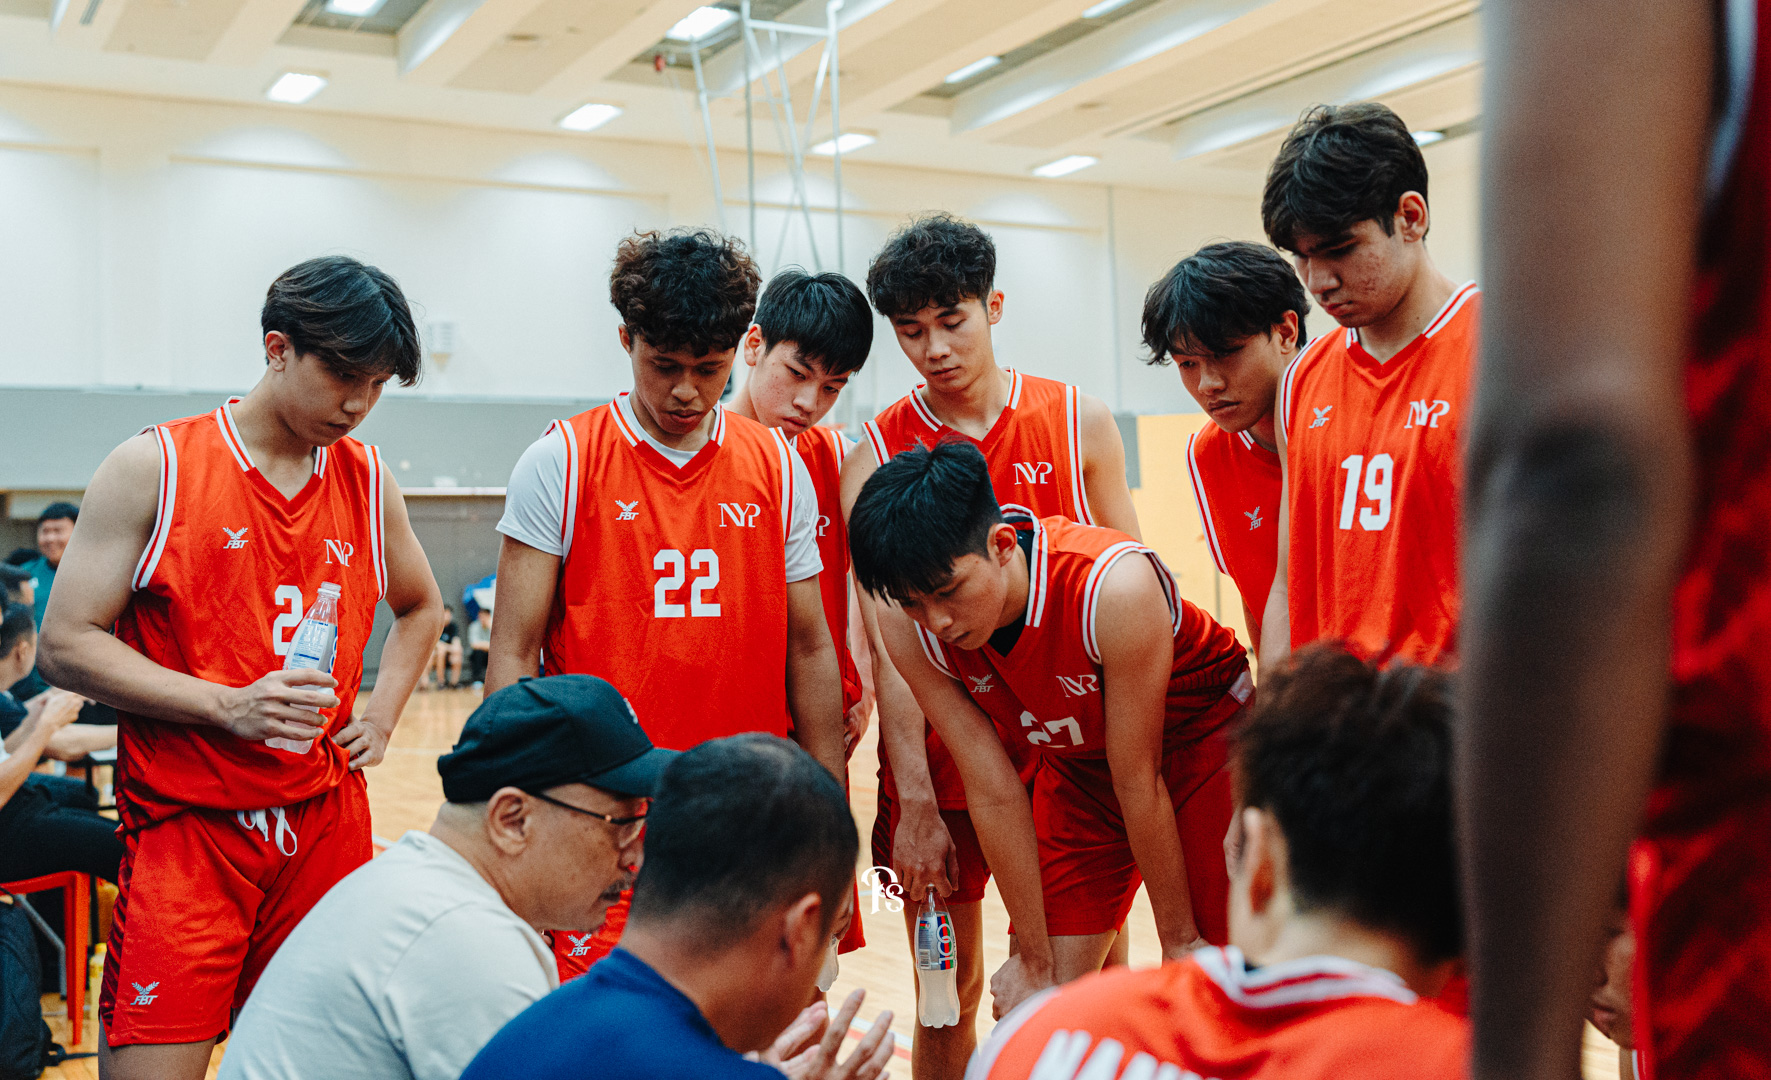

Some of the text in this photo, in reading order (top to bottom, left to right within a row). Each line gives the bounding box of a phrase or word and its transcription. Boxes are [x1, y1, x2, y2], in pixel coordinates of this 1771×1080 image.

[1404, 399, 1450, 429] NYP
[1013, 461, 1053, 485] NYP
[1339, 453, 1394, 531] 19
[615, 511, 639, 521] FBT
[718, 502, 761, 528] NYP
[223, 539, 249, 549] FBT
[323, 539, 354, 567] NYP
[653, 548, 721, 618] 22
[971, 684, 995, 693] FBT
[1056, 674, 1100, 698] NYP
[1020, 710, 1085, 748] 27
[568, 946, 592, 957] FBT
[130, 994, 159, 1005] FBT
